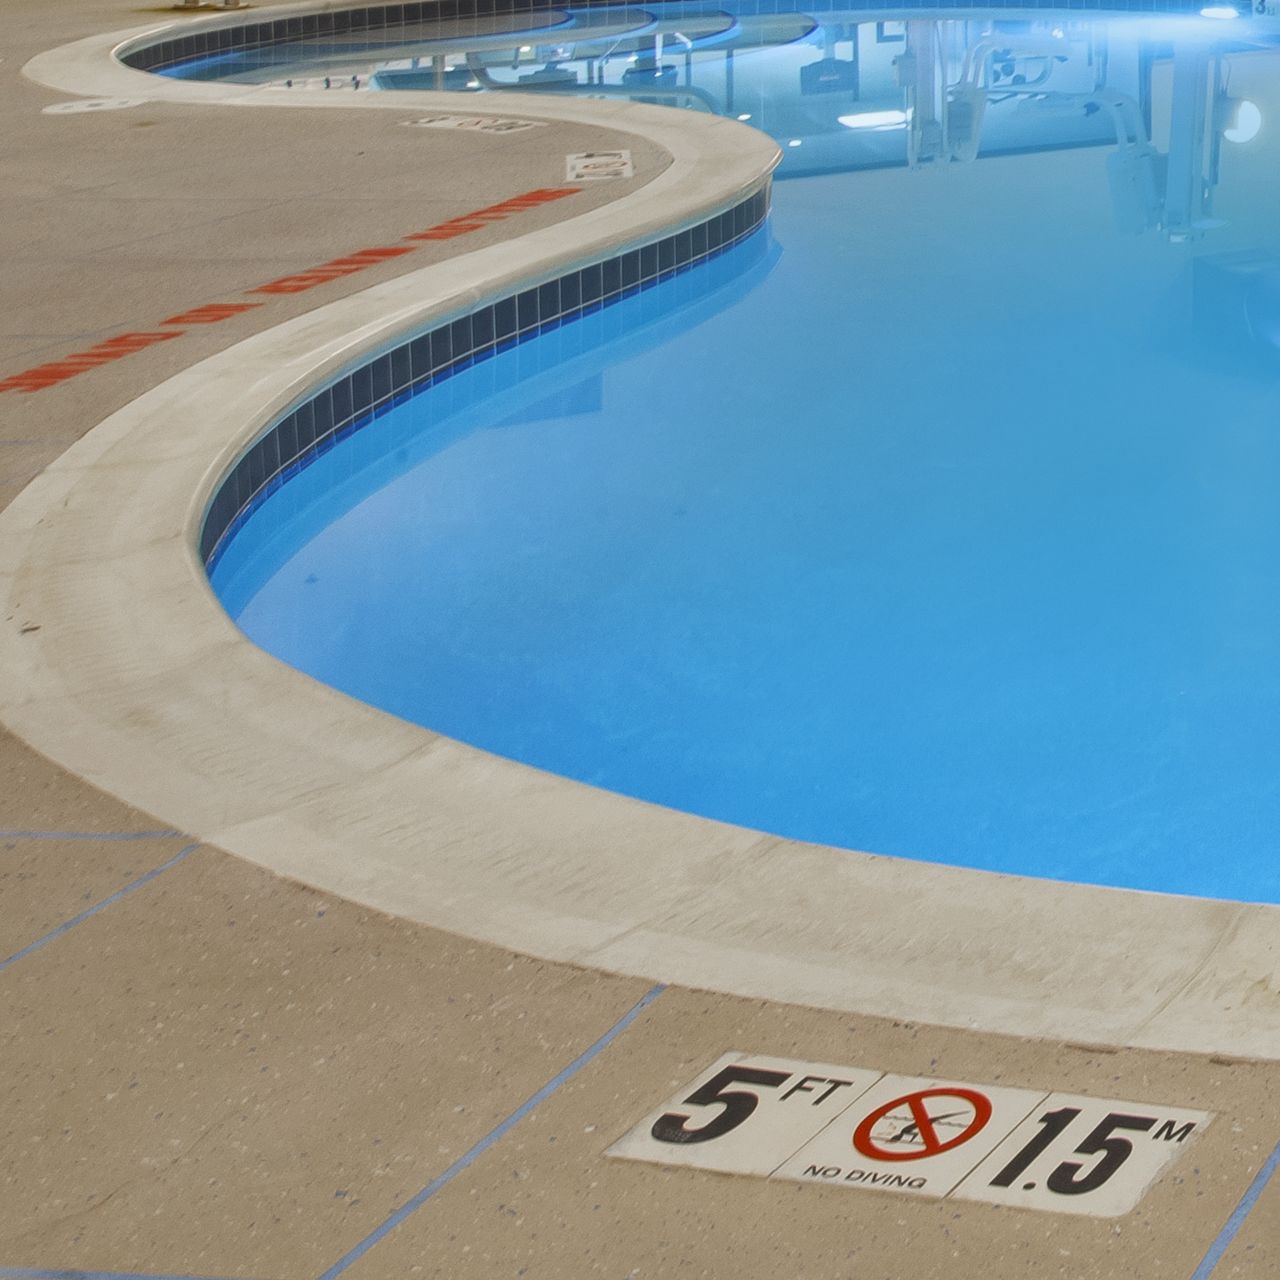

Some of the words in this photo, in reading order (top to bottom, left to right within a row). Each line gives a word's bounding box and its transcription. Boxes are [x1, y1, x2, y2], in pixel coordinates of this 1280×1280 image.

[651, 1064, 794, 1144] 5
[778, 1075, 854, 1106] FT
[802, 1164, 842, 1179] NO
[845, 1169, 928, 1189] DIVING
[988, 1107, 1159, 1196] 1.5
[1152, 1120, 1197, 1143] M
